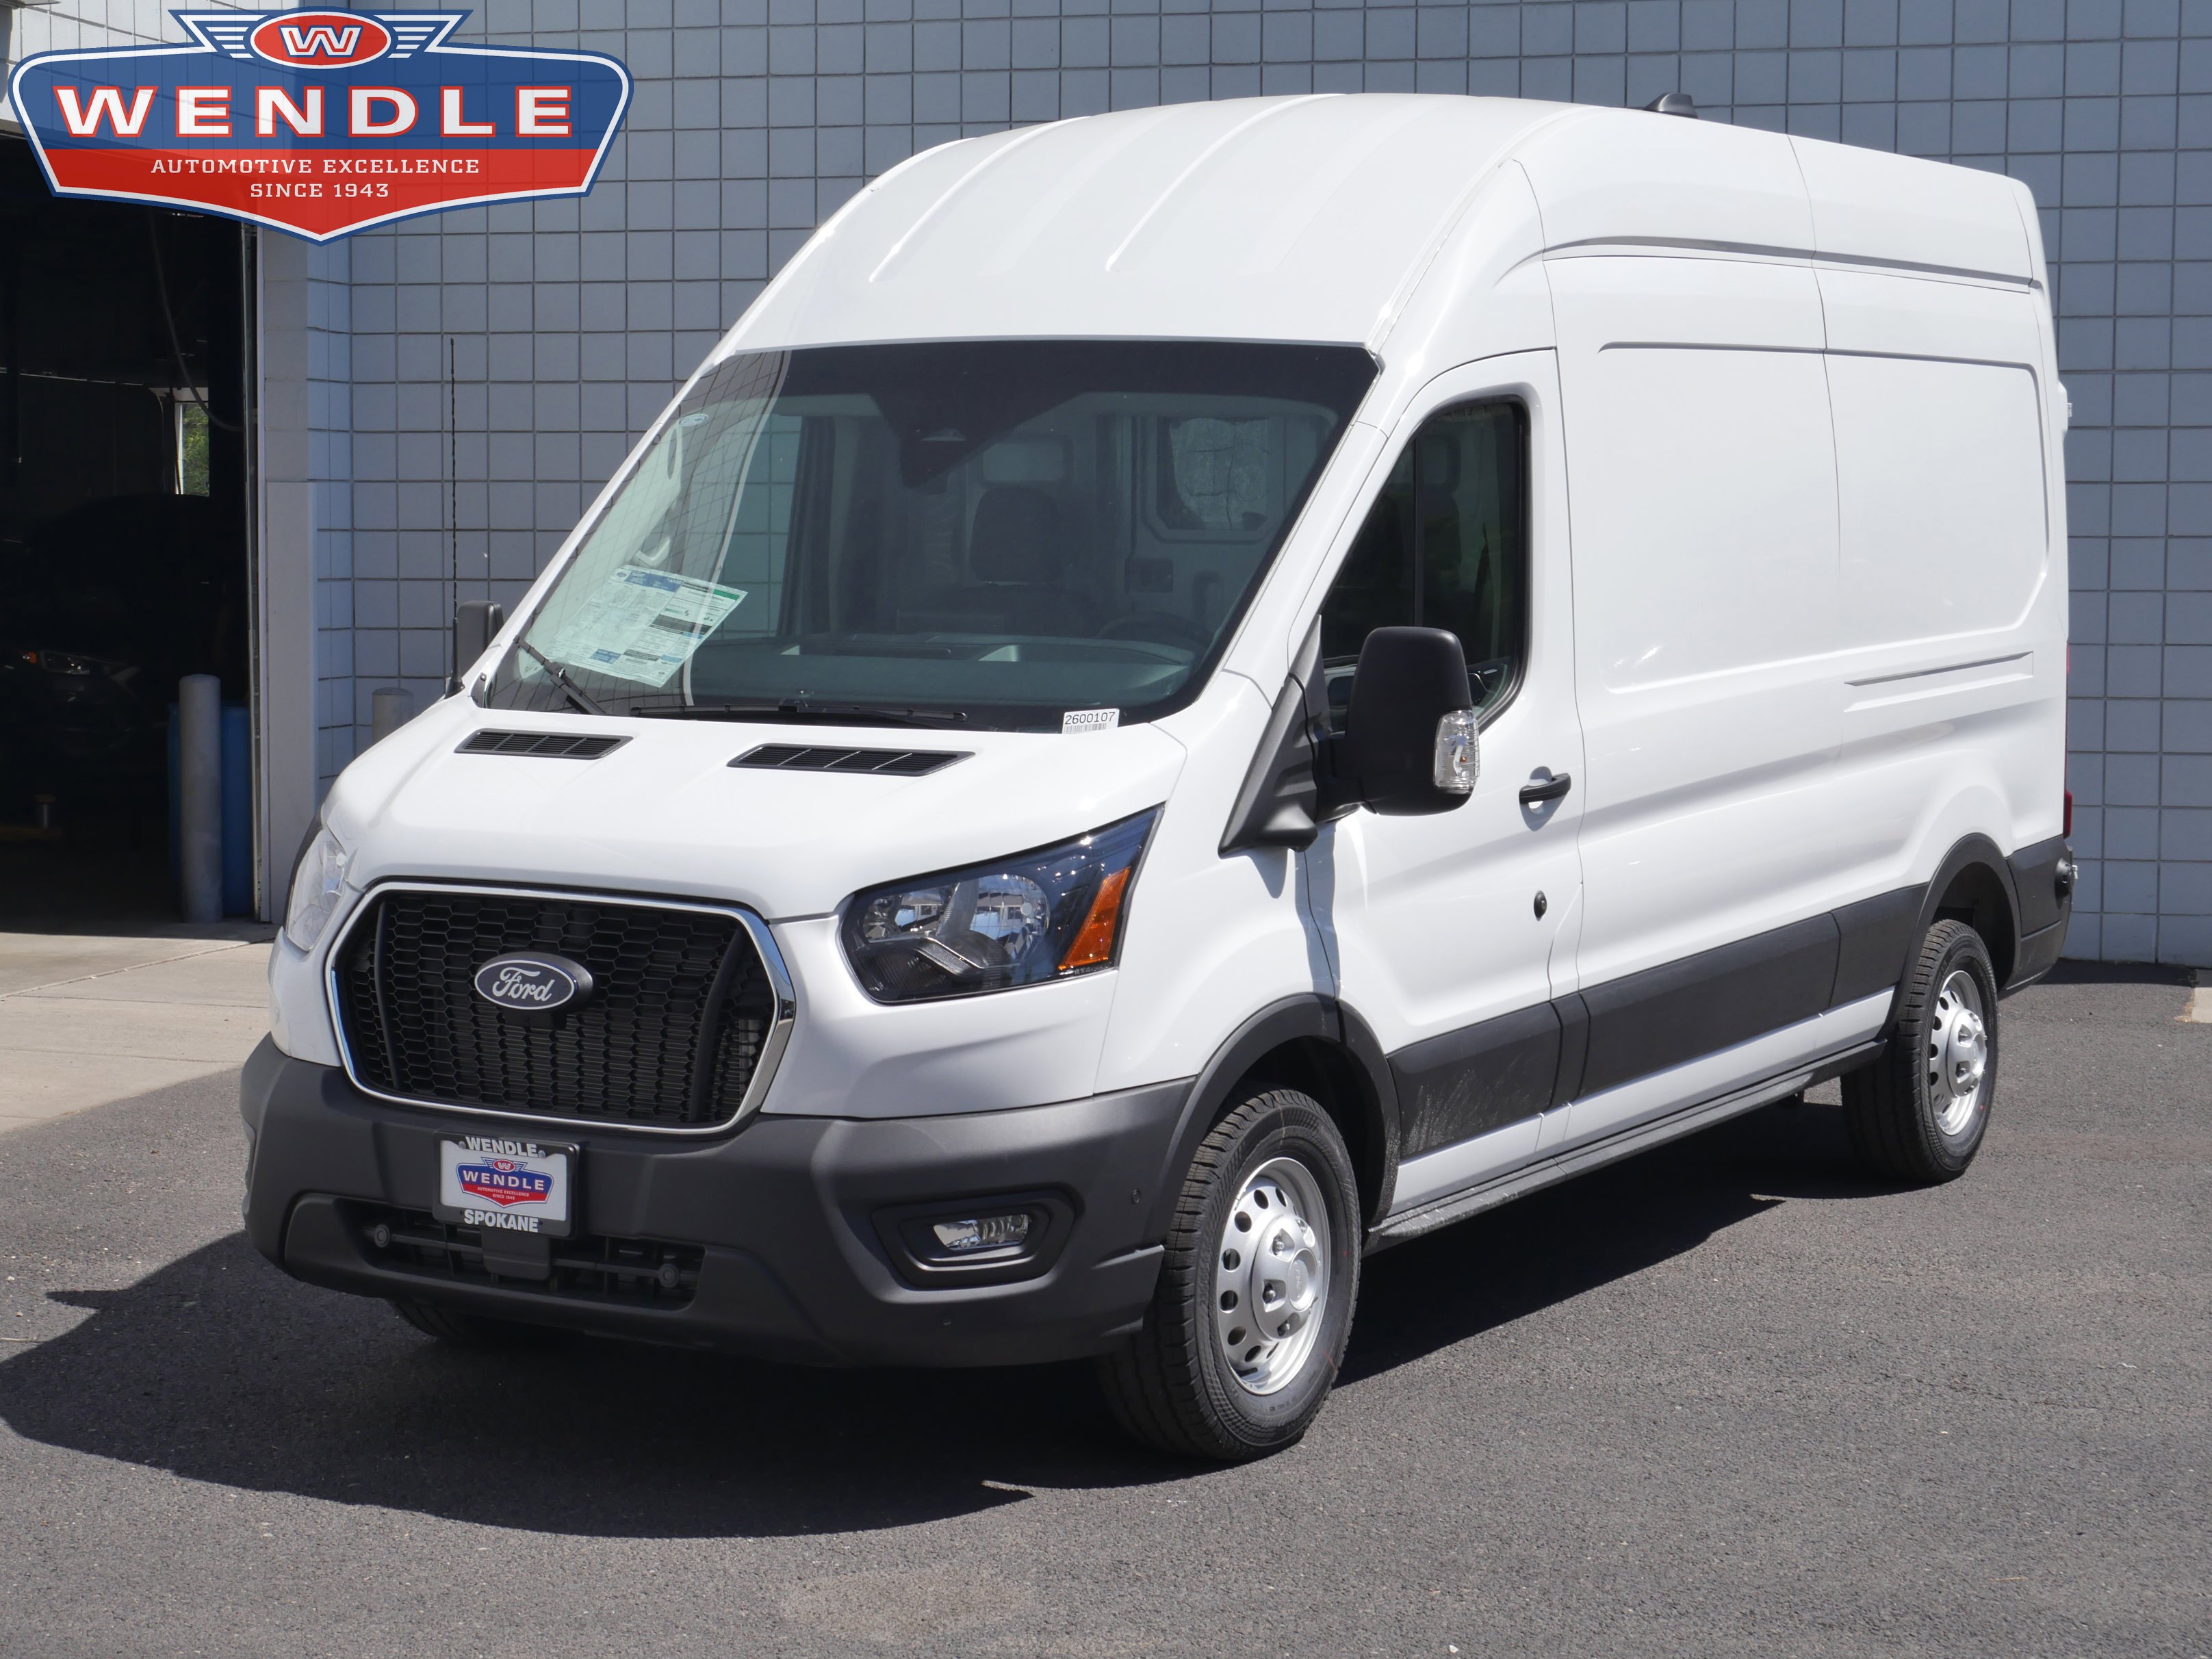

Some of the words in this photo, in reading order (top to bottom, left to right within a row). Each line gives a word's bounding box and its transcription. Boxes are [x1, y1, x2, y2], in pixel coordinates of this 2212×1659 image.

[1064, 711, 1116, 725] 2600107
[492, 966, 555, 1002] Ford
[465, 1136, 539, 1158] WENDLE
[463, 1170, 544, 1191] WENDLE
[464, 1209, 539, 1233] SPOKANE
